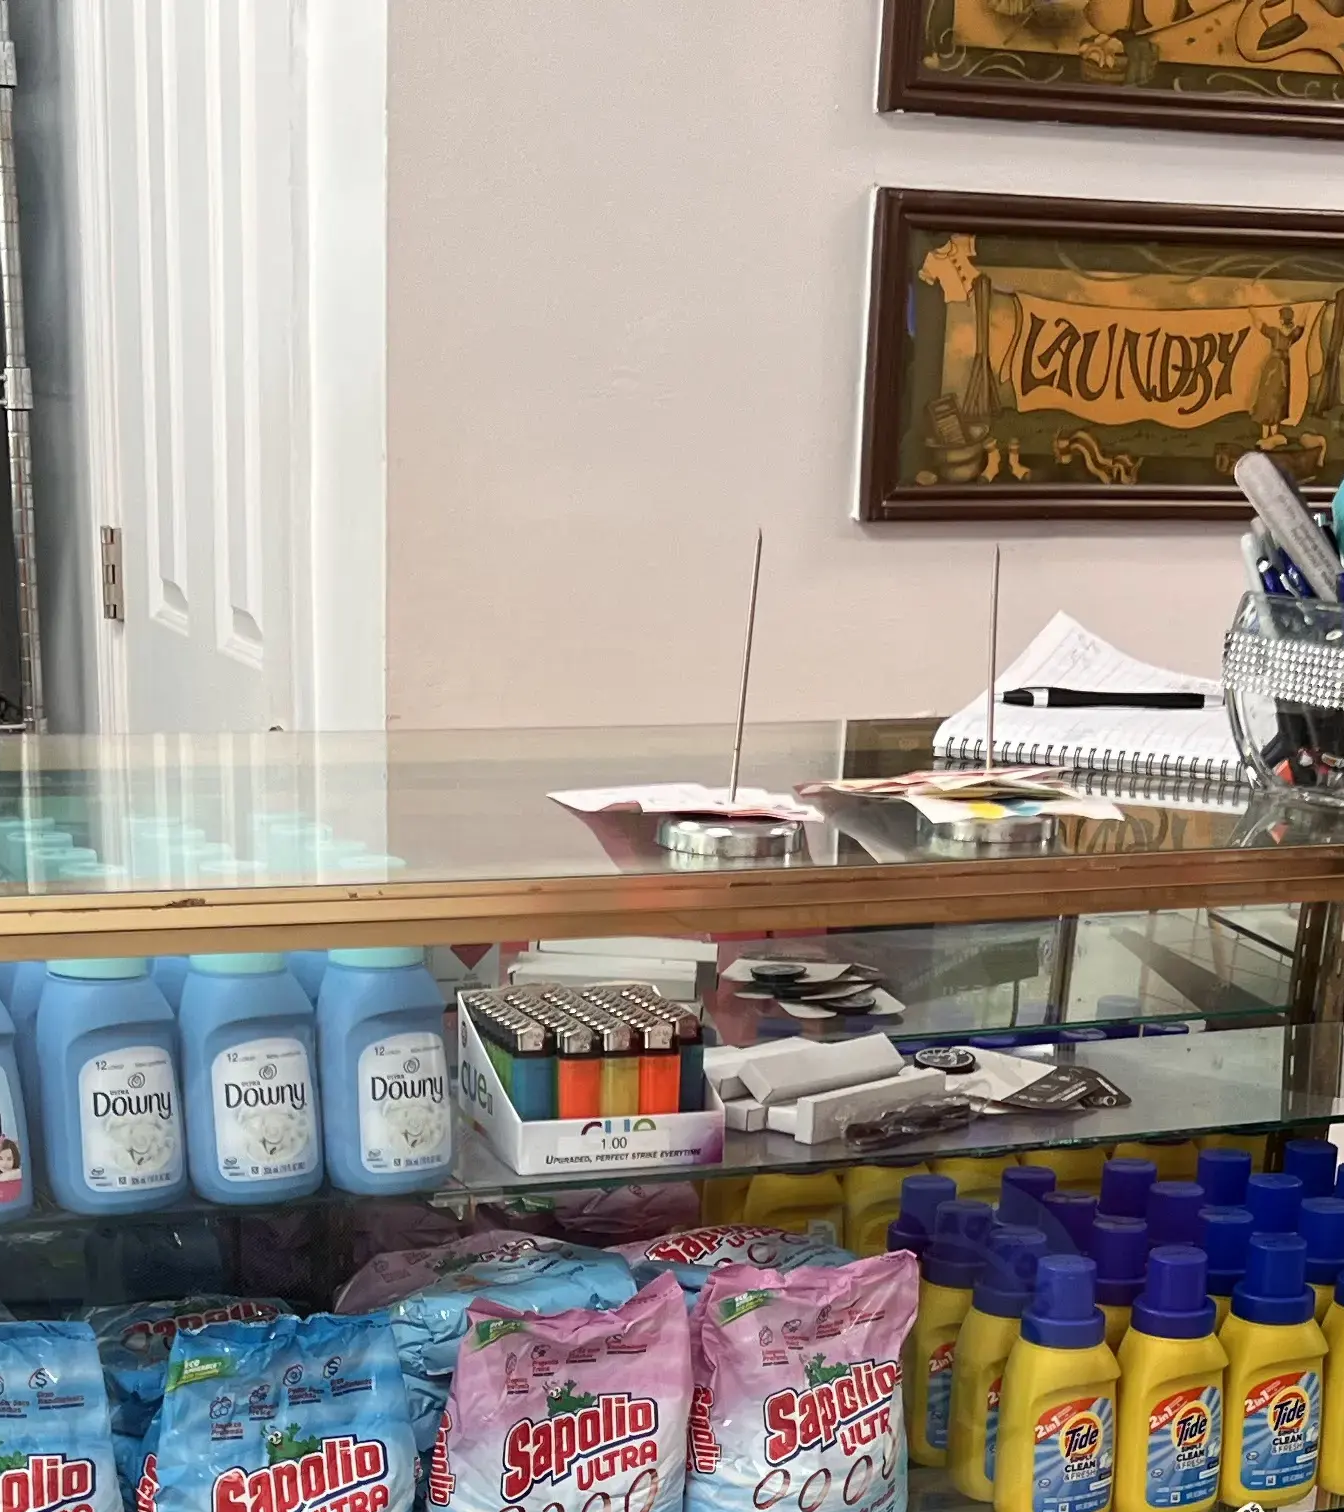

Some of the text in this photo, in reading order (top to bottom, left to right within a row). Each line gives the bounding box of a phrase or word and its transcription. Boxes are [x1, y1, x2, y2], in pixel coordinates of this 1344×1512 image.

[1020, 311, 1251, 415] LAUNDRY
[227, 1053, 238, 1063] 12
[374, 1046, 385, 1056] 12
[95, 1061, 107, 1071] 12
[224, 1082, 305, 1110] Downy
[370, 1075, 445, 1103] Downy
[93, 1089, 172, 1119] Downy
[601, 1137, 628, 1150] 1.00
[763, 1359, 901, 1467] Sapolio
[1272, 1399, 1306, 1430] Tide
[1065, 1425, 1099, 1455] Tide
[1176, 1413, 1208, 1445] Tide
[1272, 1432, 1303, 1445] CLEAN
[501, 1392, 658, 1504] Sapolio
[1176, 1449, 1205, 1462] CLEAN
[576, 1440, 657, 1491] ULTRA
[1064, 1461, 1096, 1473] CLEAN
